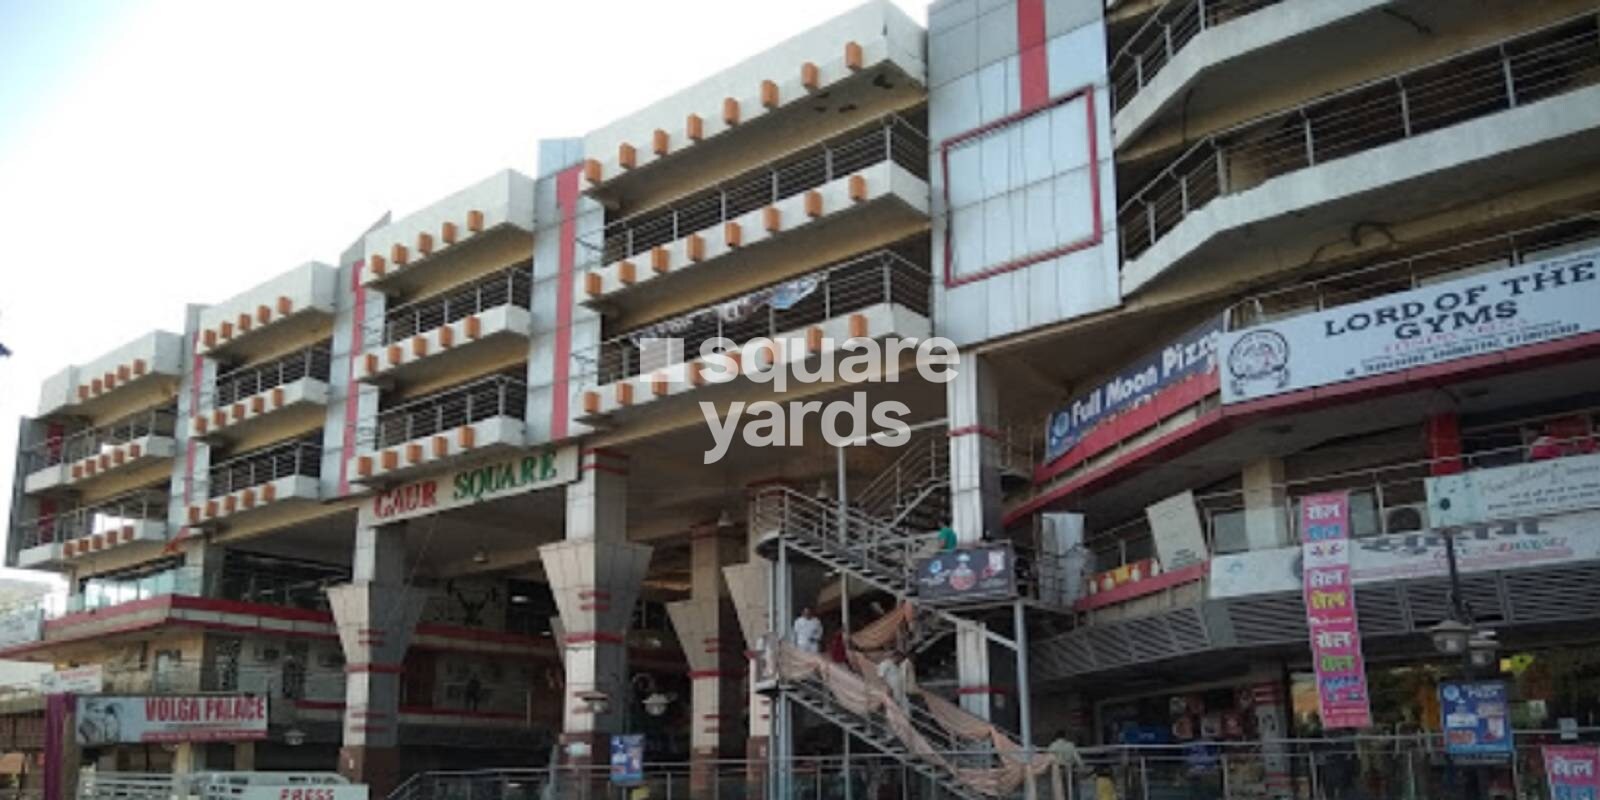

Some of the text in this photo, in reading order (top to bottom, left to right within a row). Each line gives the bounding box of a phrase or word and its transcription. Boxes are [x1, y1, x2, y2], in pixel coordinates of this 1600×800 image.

[1325, 302, 1425, 337] LORD
[1435, 284, 1488, 312] OF
[1501, 261, 1597, 297] THE
[1394, 301, 1519, 340] GYMS
[1072, 388, 1102, 427] Full
[1105, 364, 1159, 408] Moon
[374, 449, 558, 519] GAUR SQUARE
[144, 695, 265, 721] VOLGA PALACE
